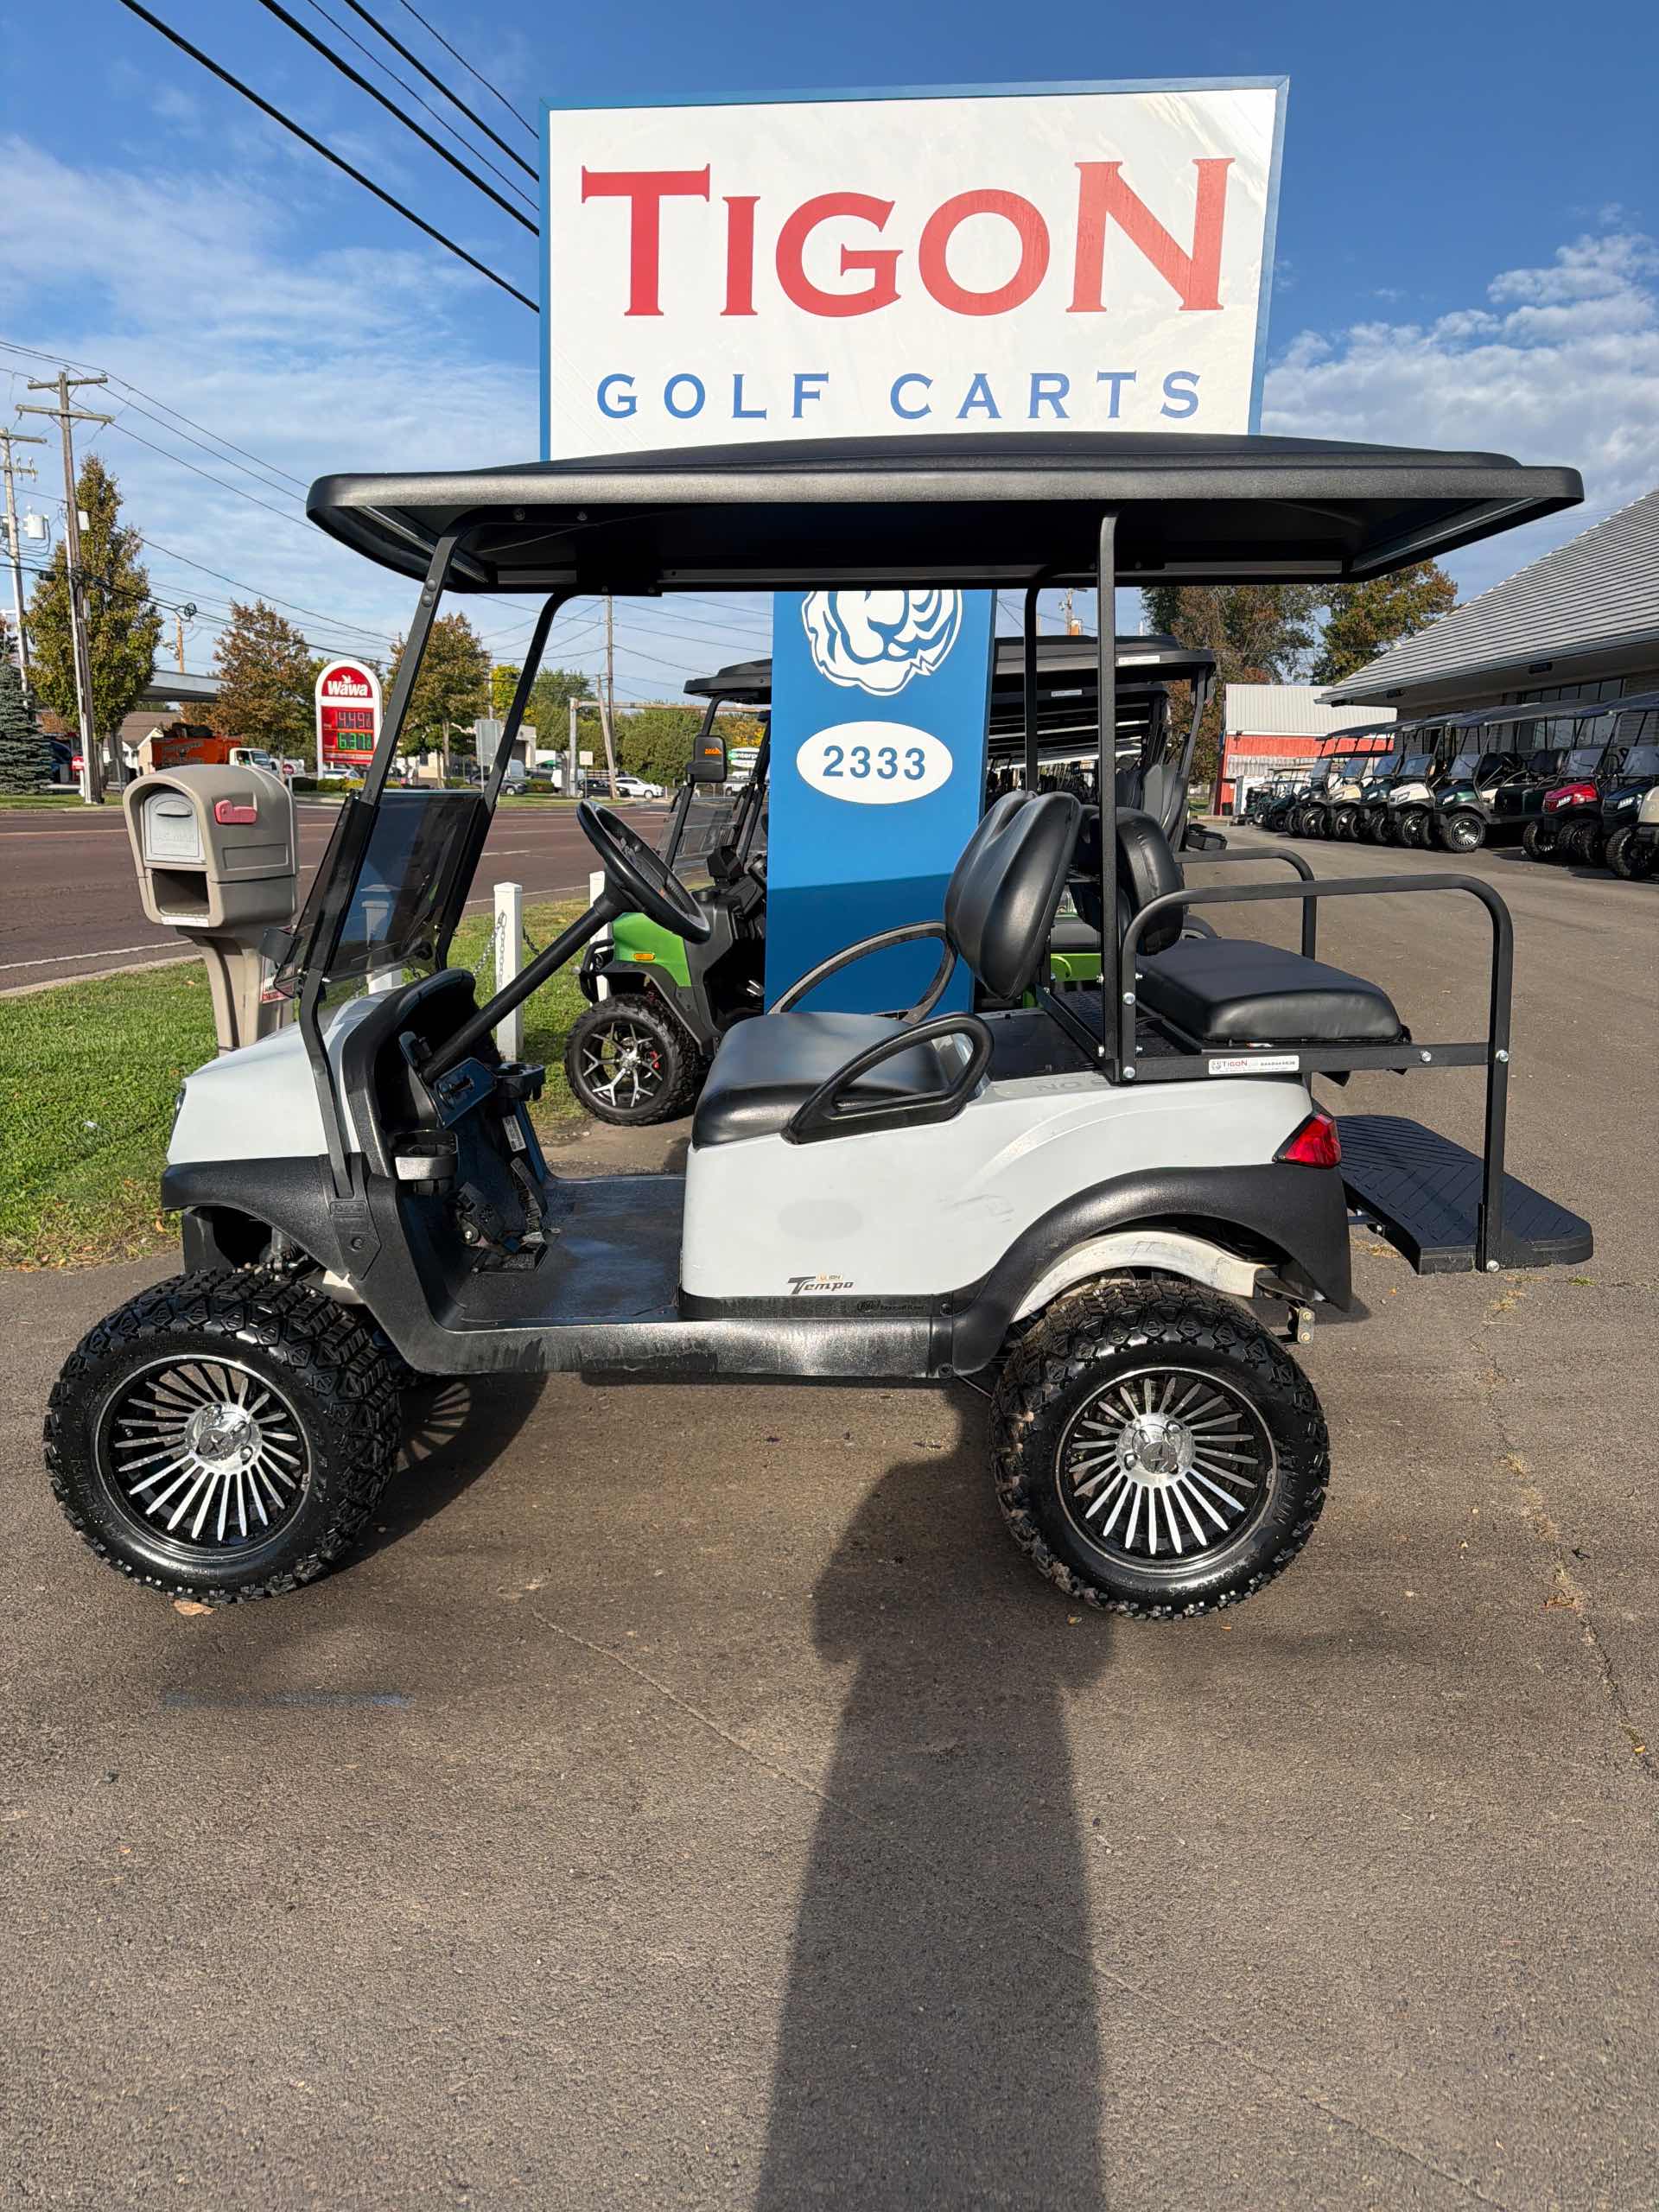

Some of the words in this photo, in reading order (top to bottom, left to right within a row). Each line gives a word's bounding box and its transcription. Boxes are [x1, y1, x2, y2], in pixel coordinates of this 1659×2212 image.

[582, 157, 1236, 318] TIGON
[596, 371, 830, 420] GOLF
[890, 371, 1202, 421] CARTS
[327, 680, 368, 696] Wawa
[822, 745, 926, 780] 2333
[788, 1275, 854, 1294] Tempo
